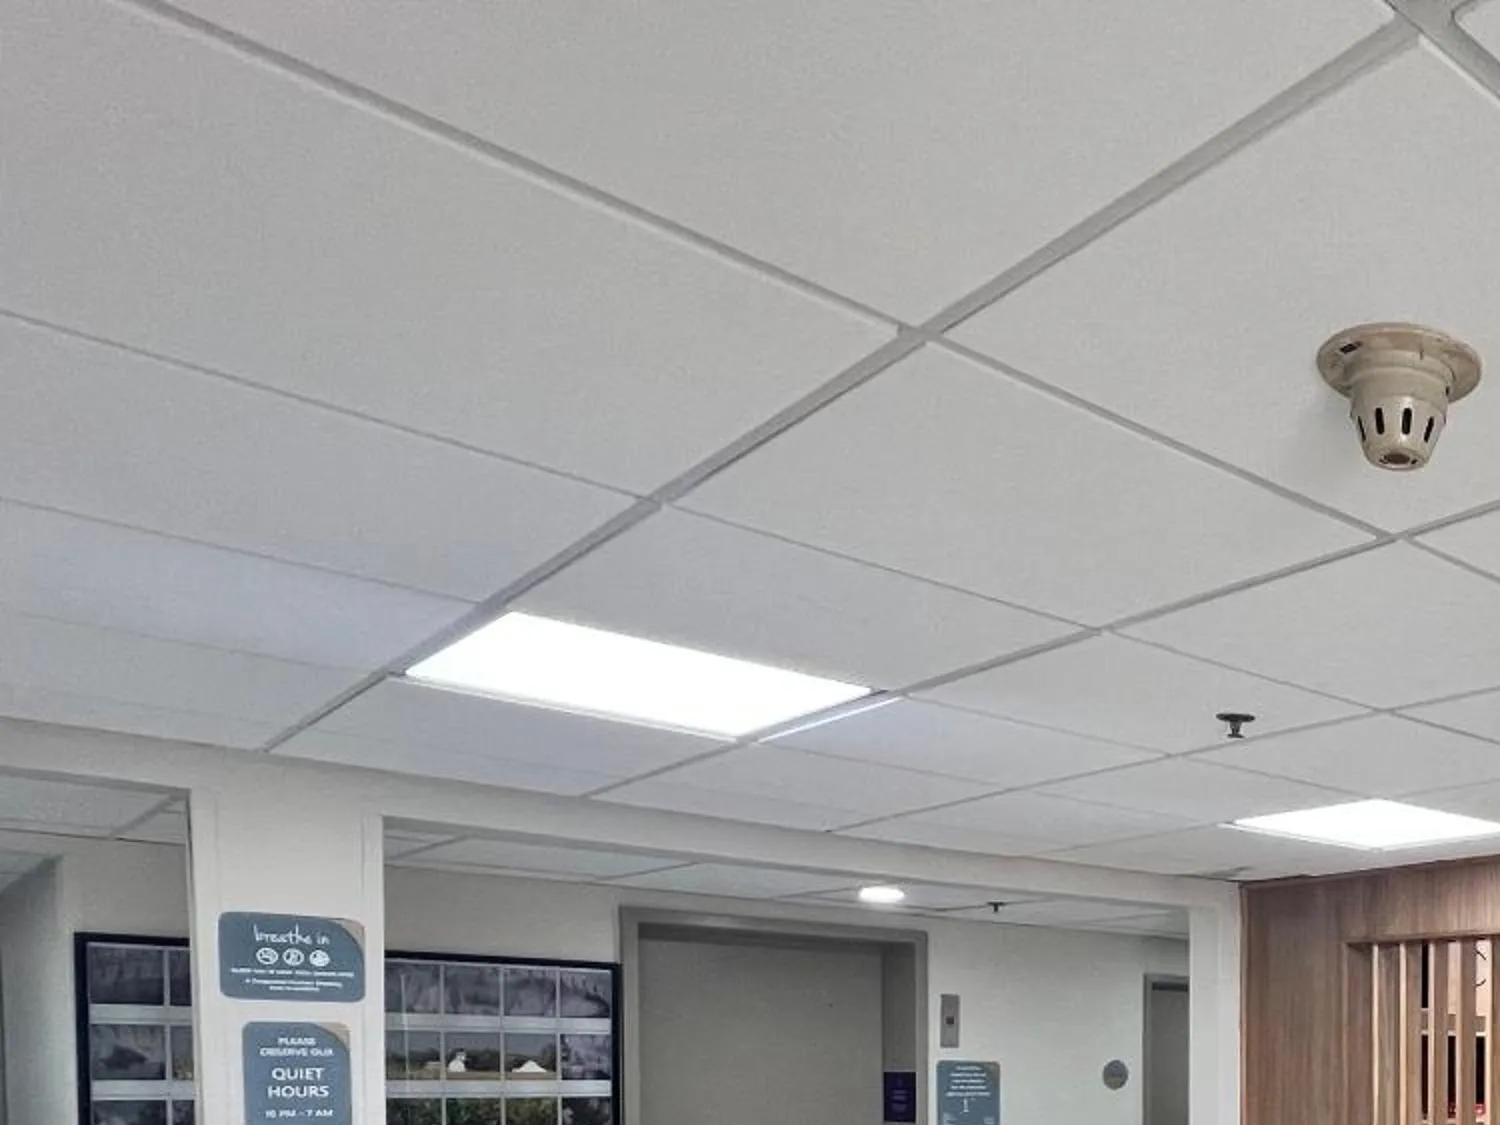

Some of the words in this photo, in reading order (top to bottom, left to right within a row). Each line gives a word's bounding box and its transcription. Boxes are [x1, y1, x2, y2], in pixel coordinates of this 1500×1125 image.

[253, 922, 312, 945] breathe
[316, 932, 330, 945] in
[277, 1036, 317, 1046] PLEASE
[259, 1047, 308, 1057] OBSERVE
[309, 1047, 333, 1057] OUR
[271, 1067, 325, 1081] QUIET
[267, 1085, 330, 1099] HOURS
[278, 1109, 296, 1117] PM
[315, 1109, 334, 1117] AM
